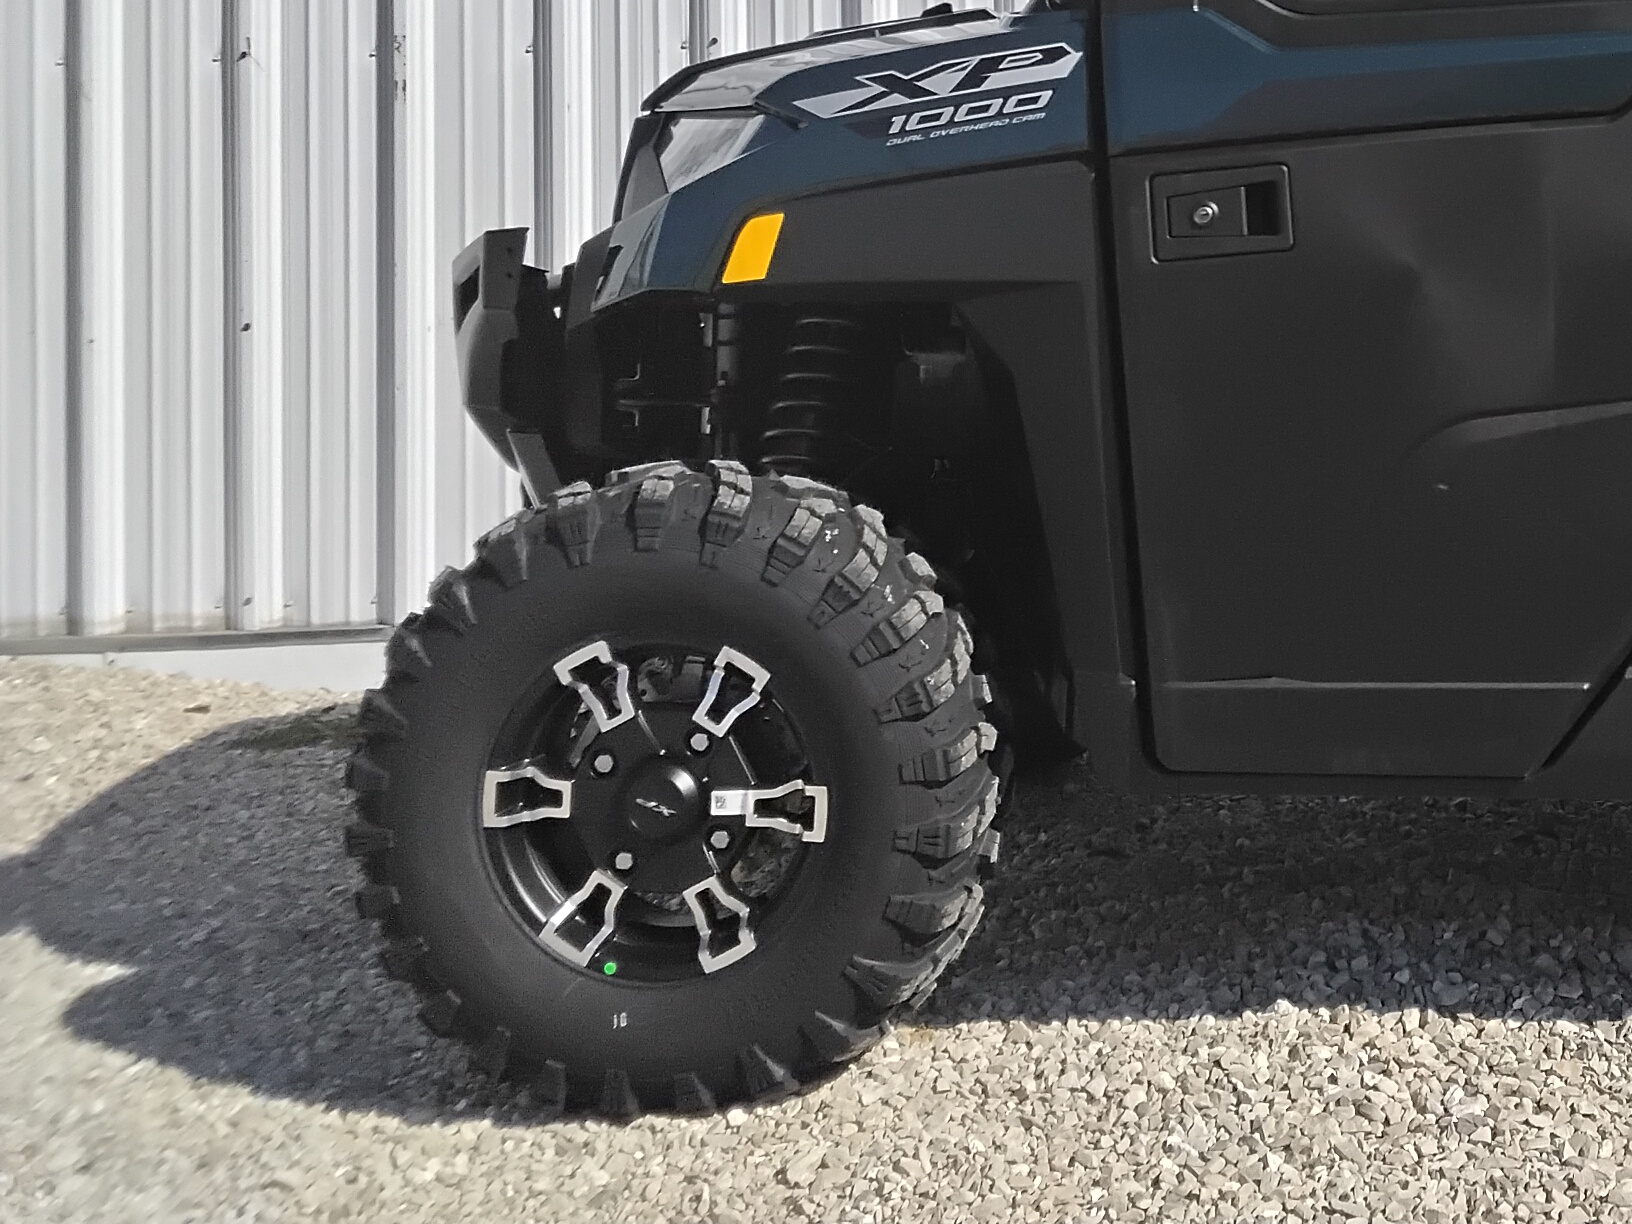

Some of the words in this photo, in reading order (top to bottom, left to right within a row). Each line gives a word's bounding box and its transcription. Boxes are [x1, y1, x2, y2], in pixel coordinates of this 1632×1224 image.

[829, 42, 1075, 117] XP
[886, 134, 925, 147] DUAL
[930, 118, 1010, 139] OVERHEAD
[1012, 112, 1047, 125] CAM
[888, 89, 1055, 134] 1000
